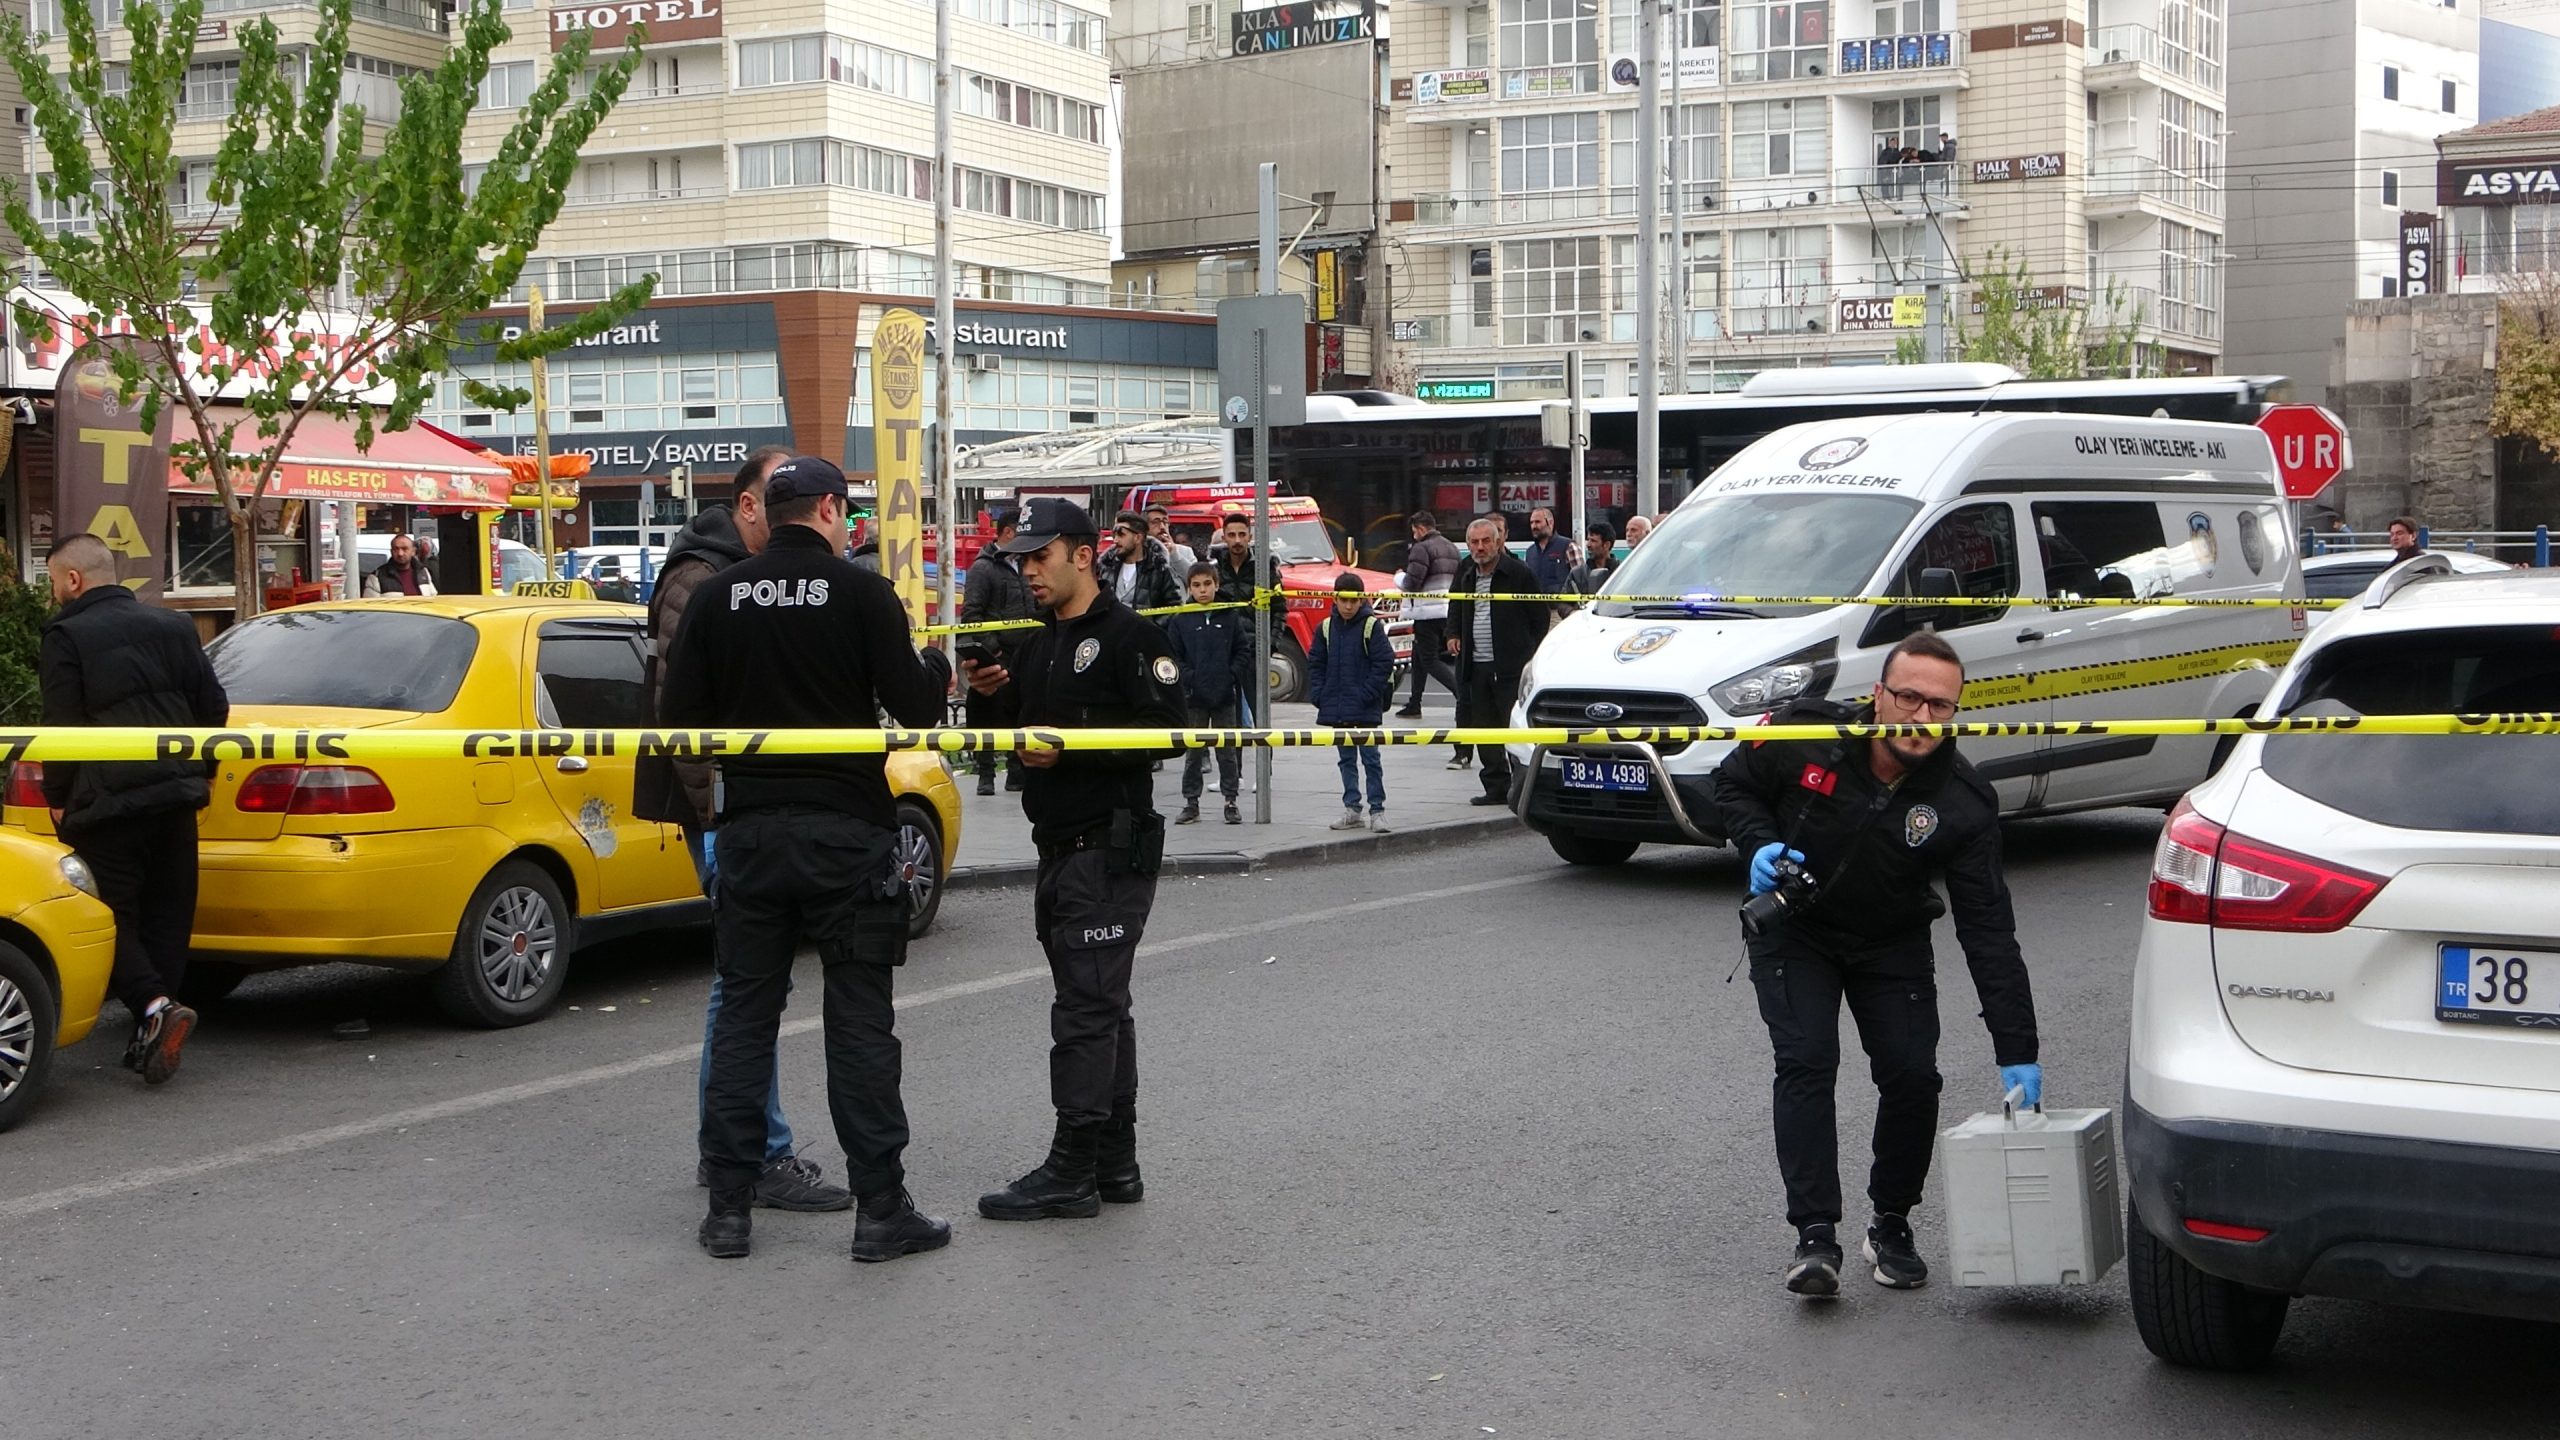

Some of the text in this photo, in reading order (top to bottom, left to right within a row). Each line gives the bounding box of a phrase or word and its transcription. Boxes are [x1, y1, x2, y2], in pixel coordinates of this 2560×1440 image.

[554, 0, 719, 32] HOTEL
[1241, 6, 1292, 32] KLAS
[1679, 57, 1715, 68] AREKETİ
[1976, 154, 2060, 175] HALK NEOVA
[2463, 170, 2560, 197] ASYA
[2406, 226, 2430, 245] ASYA
[1843, 300, 1893, 320] GÖKD
[877, 323, 923, 357] MEYDAN
[665, 443, 748, 463] BAYER
[2075, 436, 2107, 455] OLAY
[2284, 434, 2335, 469] UR
[332, 488, 363, 499] TELEFON
[1477, 485, 1550, 502] EZANE
[1719, 476, 1764, 492] OLAY
[1570, 762, 1646, 784] 38 A 4938
[2446, 982, 2466, 997] TR
[2475, 956, 2528, 1005] 38
[2228, 983, 2335, 1003] QASHQAI
[2515, 1015, 2560, 1026] ÇA
